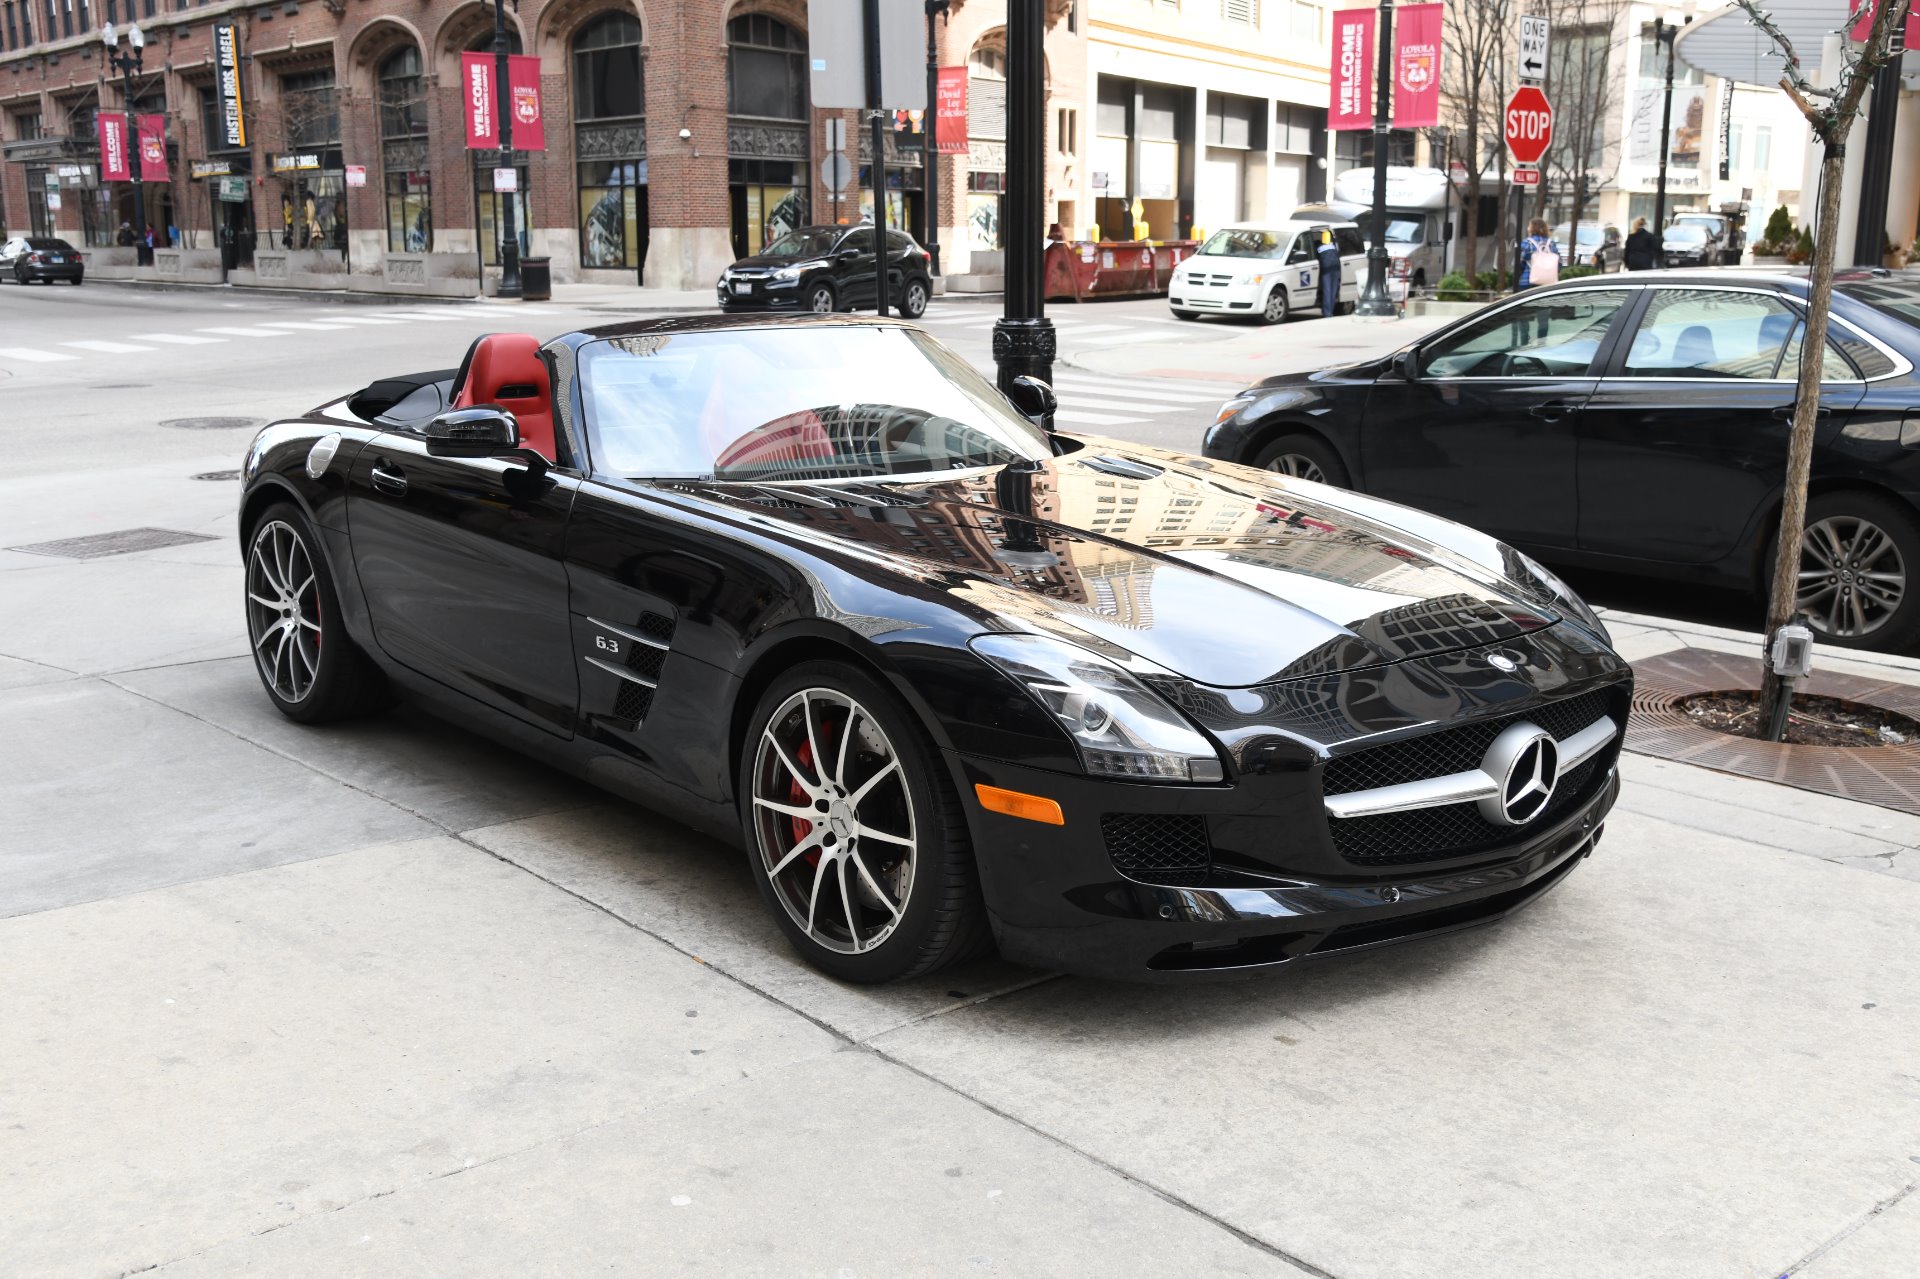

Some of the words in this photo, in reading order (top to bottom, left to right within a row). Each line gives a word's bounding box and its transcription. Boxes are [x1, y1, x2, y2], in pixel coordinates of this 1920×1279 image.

[1355, 24, 1363, 57] CAMPUS
[1524, 21, 1545, 37] ONE
[219, 27, 234, 67] BAGELS
[1401, 44, 1435, 54] LOYOLA
[1523, 39, 1545, 54] WAY
[1340, 24, 1355, 115] WELCOME
[1354, 59, 1362, 87] TOWER
[471, 64, 484, 136] WELCOME
[225, 98, 240, 144] EINSTEIN
[1508, 110, 1549, 140] STOP
[105, 121, 117, 172] WELCOME
[1515, 172, 1525, 181] ALL
[1526, 173, 1537, 182] WAY
[596, 636, 618, 652] 6.3
